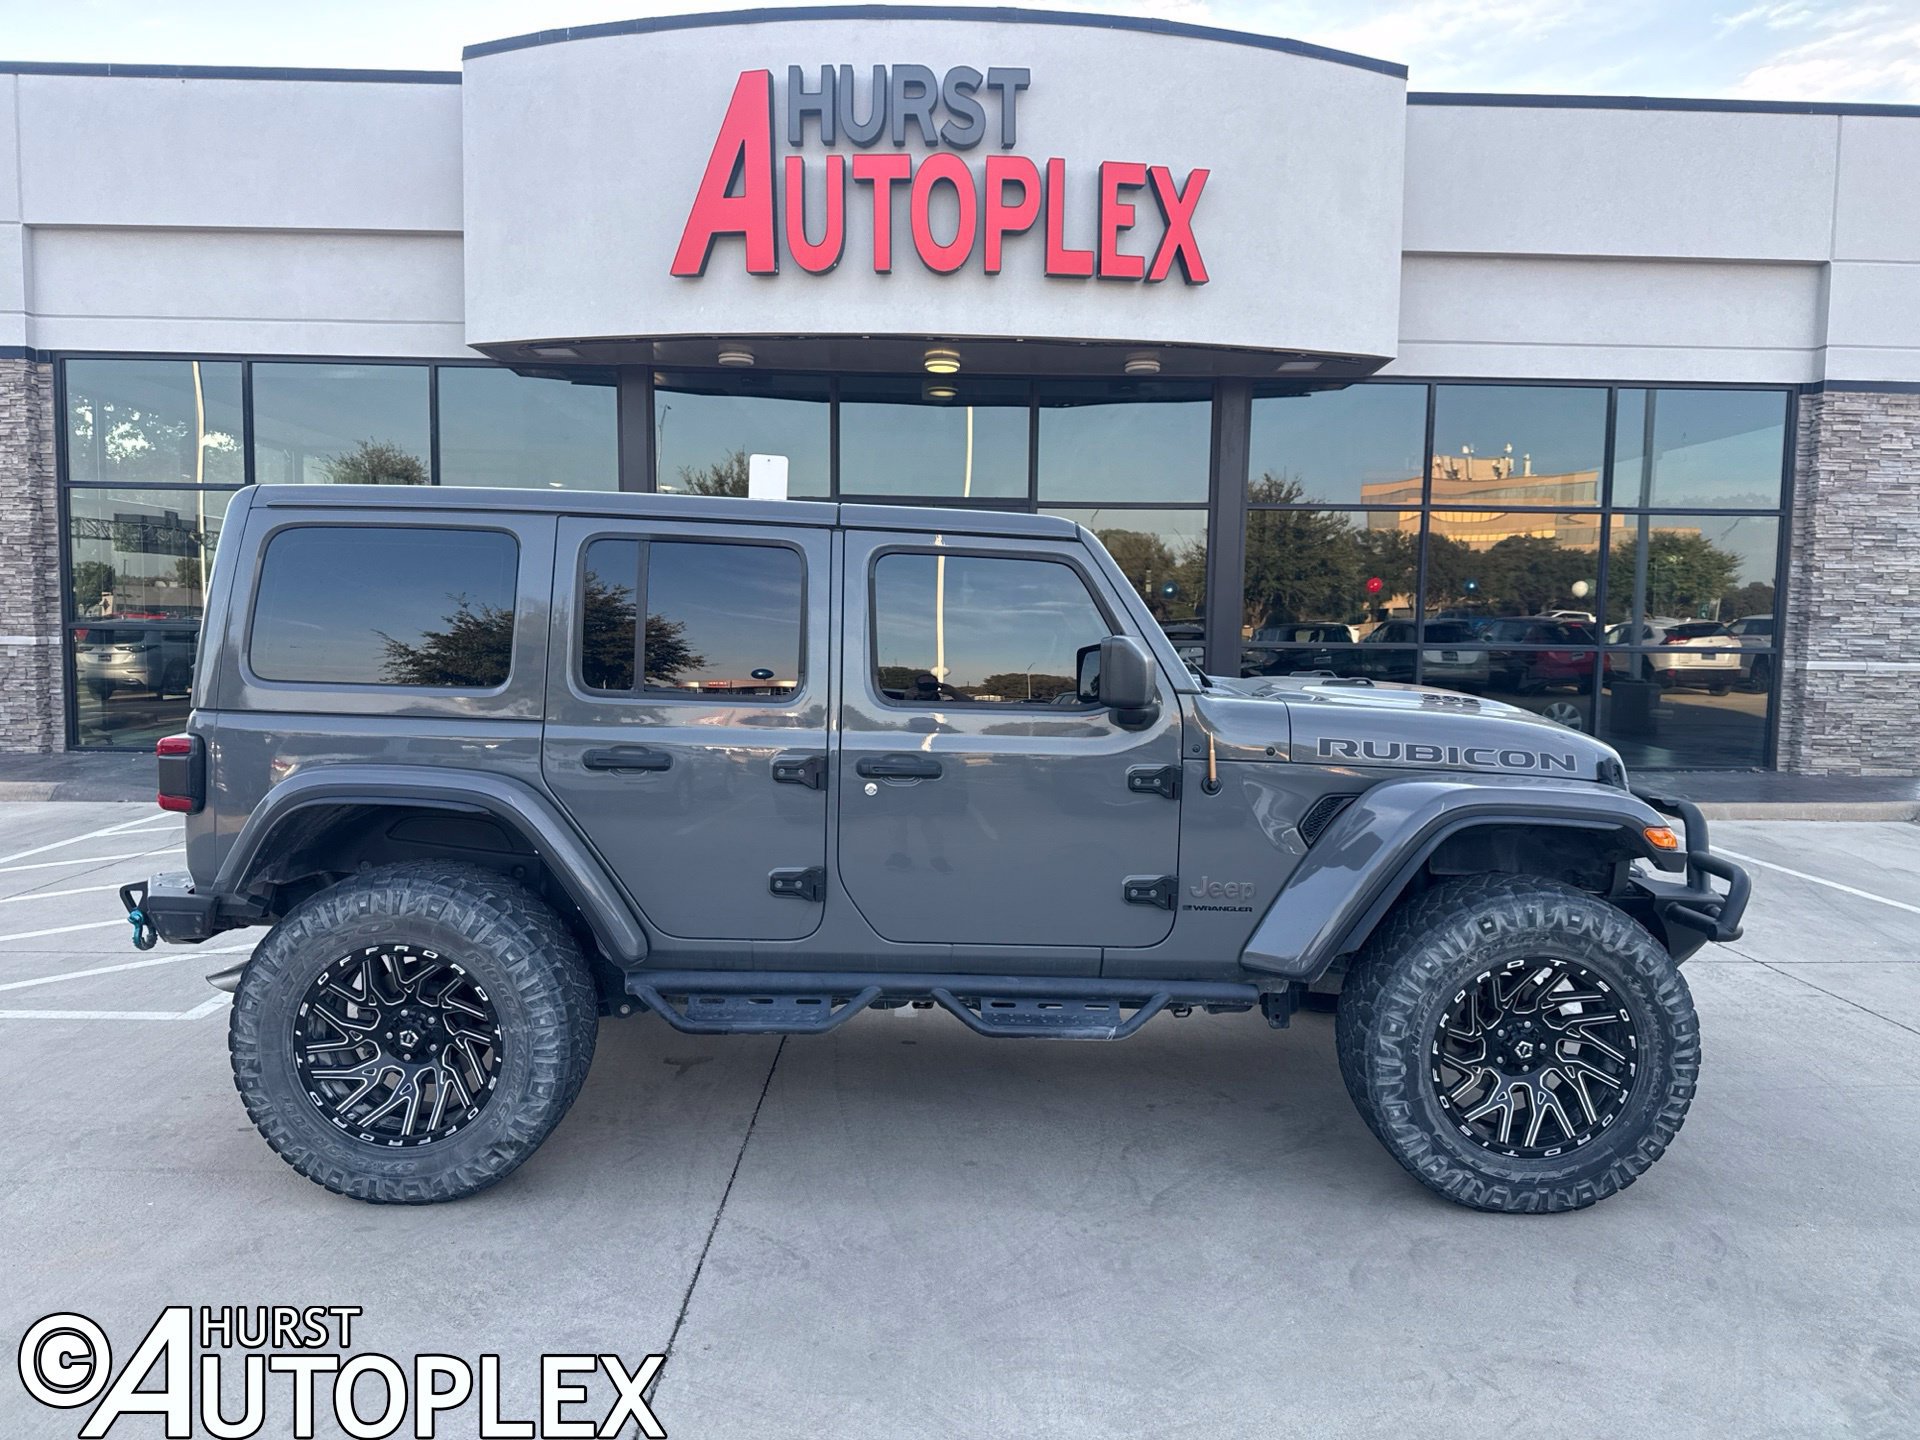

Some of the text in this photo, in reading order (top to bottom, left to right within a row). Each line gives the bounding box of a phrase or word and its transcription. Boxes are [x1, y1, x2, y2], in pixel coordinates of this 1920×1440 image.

[788, 63, 1030, 149] HURST
[670, 69, 1210, 286] AUTOPLEX
[1317, 737, 1578, 773] RUBICON
[1190, 876, 1257, 902] Jeep
